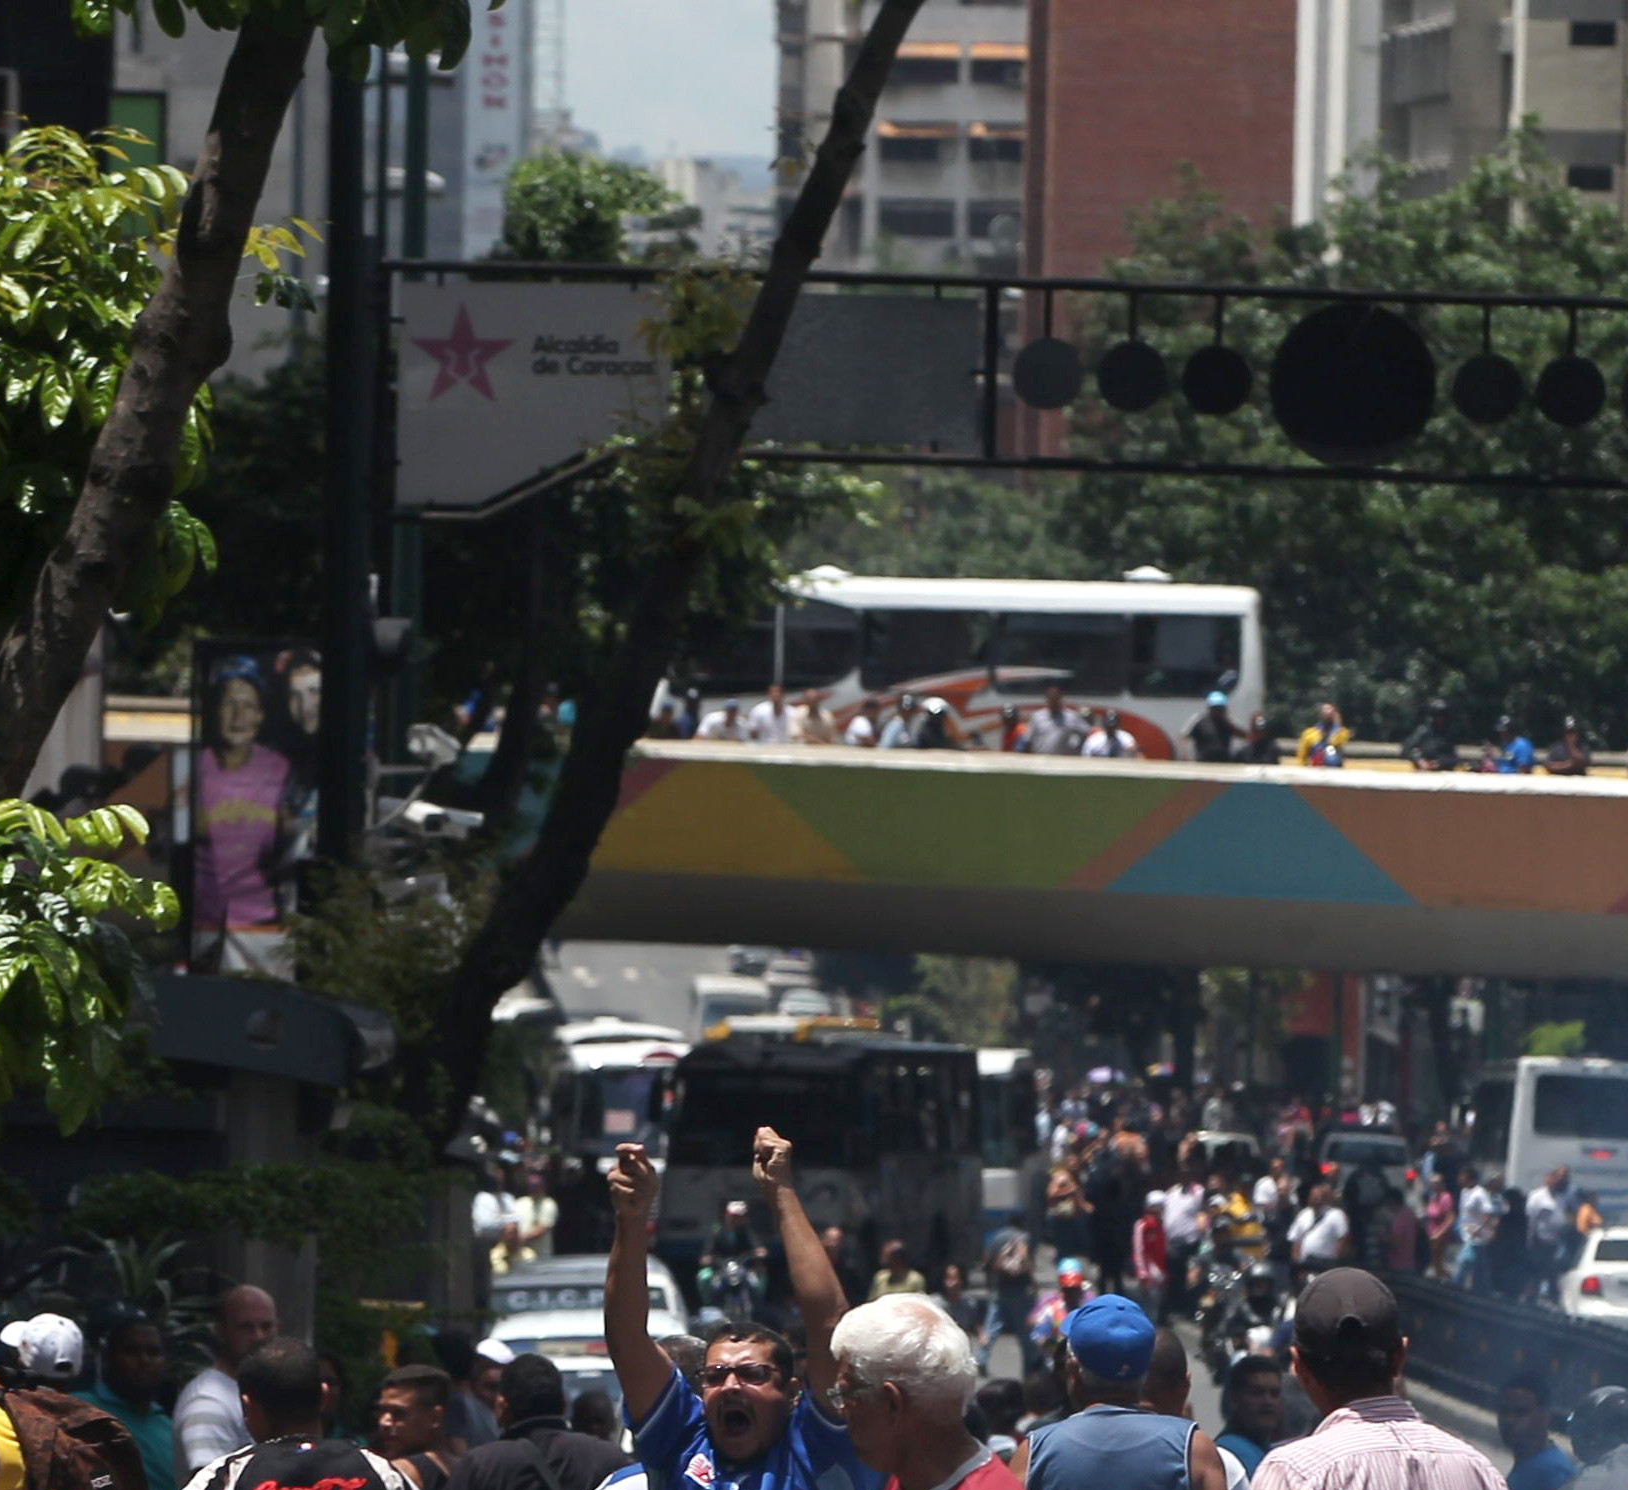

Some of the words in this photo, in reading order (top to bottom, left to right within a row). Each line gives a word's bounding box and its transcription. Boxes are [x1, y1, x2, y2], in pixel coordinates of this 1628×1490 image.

[532, 334, 620, 355] Alcaldía
[532, 357, 560, 375] de
[566, 356, 656, 376] Caracas
